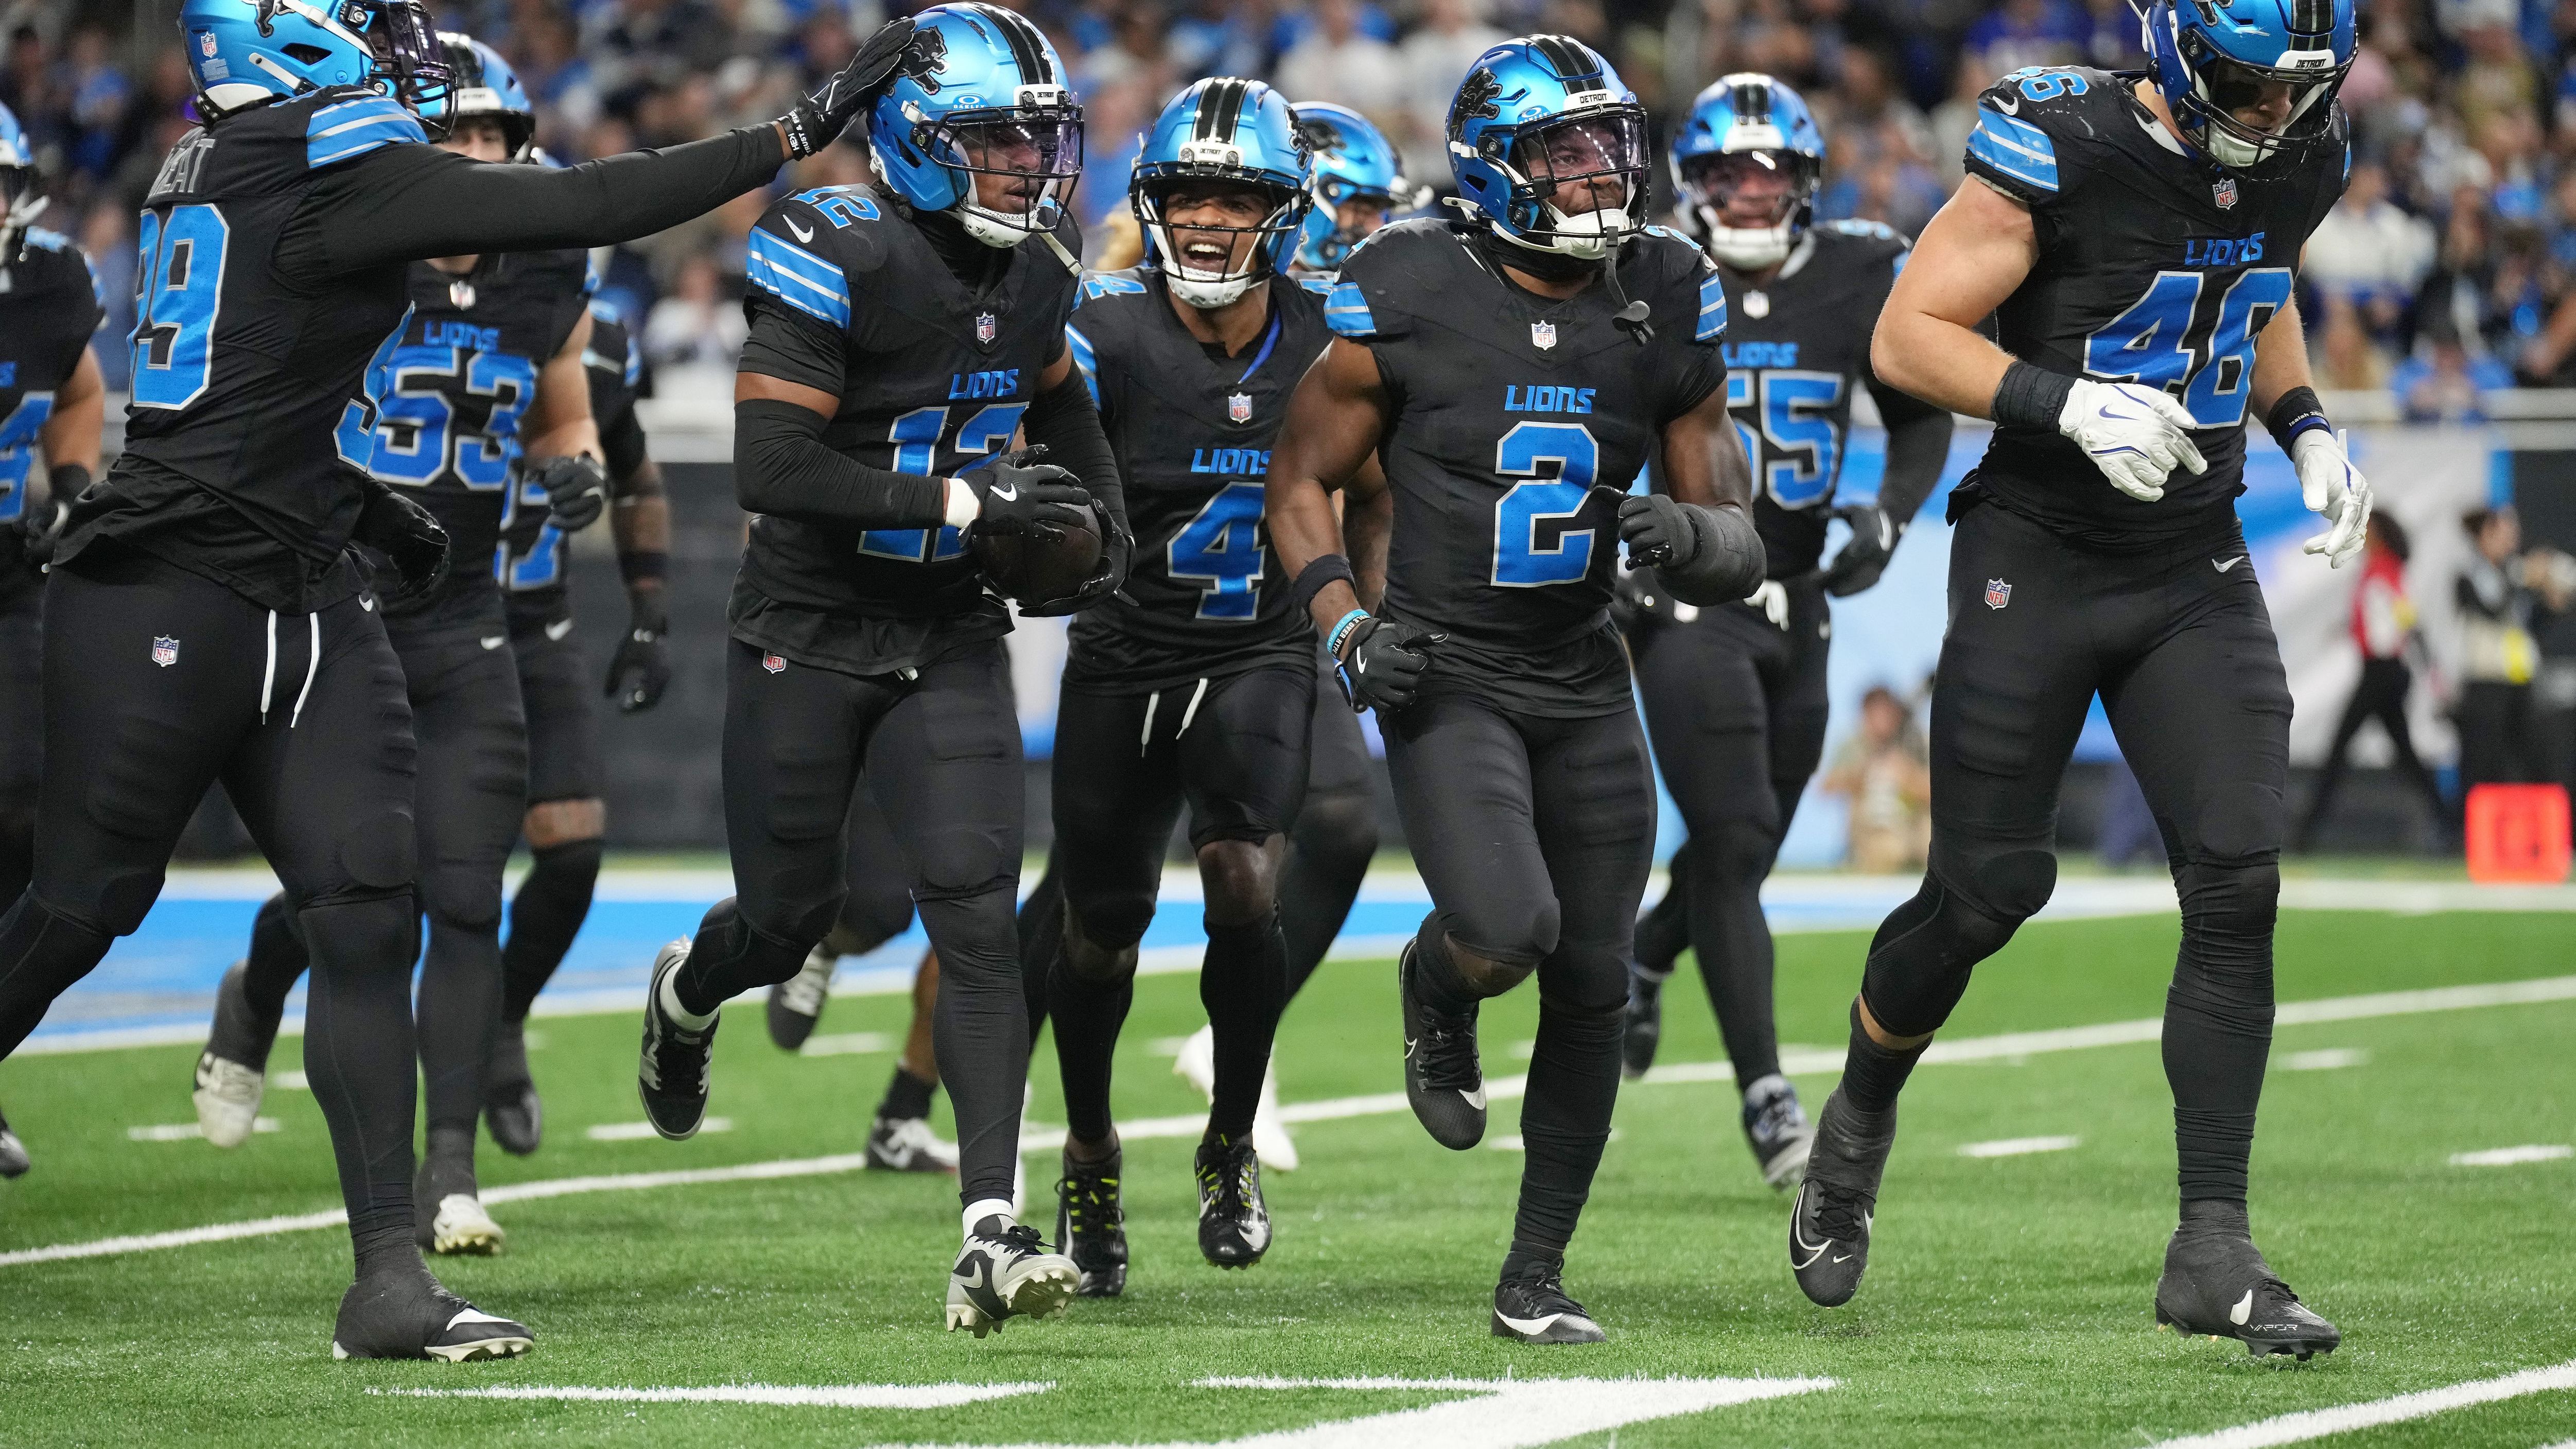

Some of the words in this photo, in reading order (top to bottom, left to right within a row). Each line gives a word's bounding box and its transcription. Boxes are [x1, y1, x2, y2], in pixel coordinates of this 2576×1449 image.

[203, 43, 215, 53] NFL
[2295, 58, 2326, 68] DETROIT
[1579, 93, 1607, 104] DETROIT
[798, 133, 812, 153] TRUST
[2218, 191, 2234, 204] NFL
[789, 185, 881, 229] 12
[2184, 232, 2265, 266] LIONS
[424, 321, 500, 352] LIONS
[980, 326, 993, 338] NFL
[1537, 334, 1553, 344] NFL
[2083, 267, 2293, 430] 46
[948, 369, 1020, 400] LIONS
[1504, 385, 1597, 414] LIONS
[1233, 407, 1248, 418] NFL
[2289, 413, 2309, 427] Isaiah
[1490, 420, 1599, 588] 2
[1167, 481, 1266, 621] 4
[1988, 591, 2004, 604] NFL
[1339, 622, 1354, 639] OVER
[1332, 638, 1343, 654] HYPE
[156, 649, 173, 661] NFL
[767, 655, 782, 668] NFL
